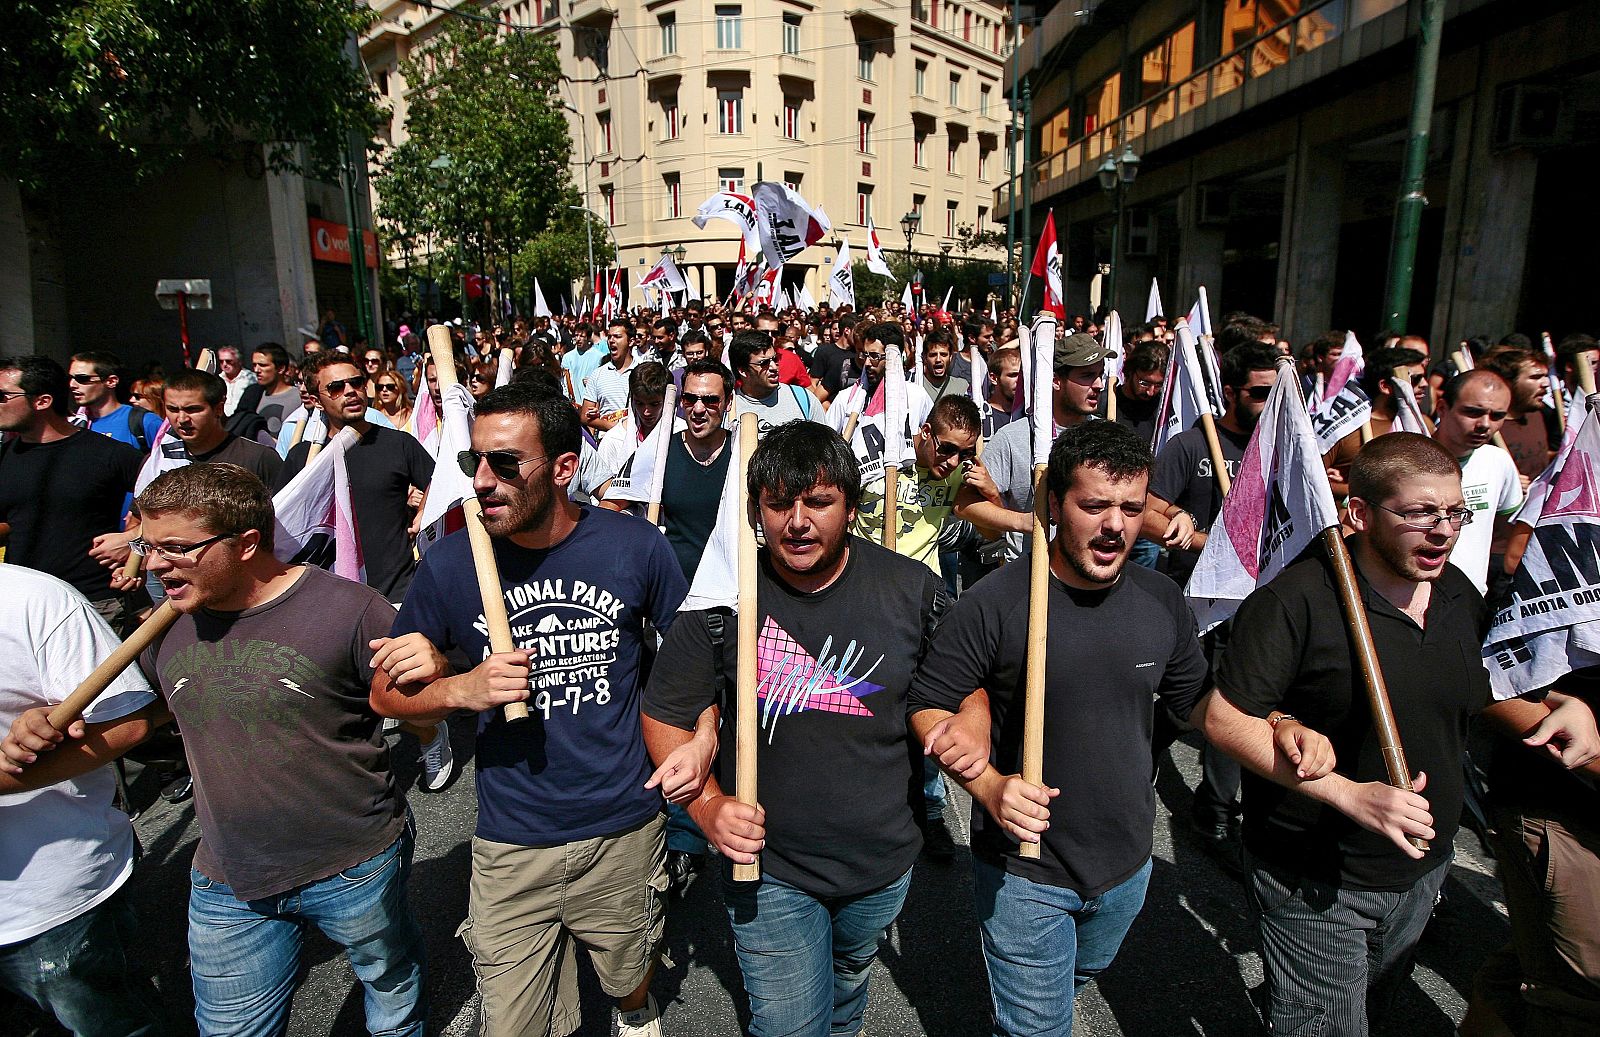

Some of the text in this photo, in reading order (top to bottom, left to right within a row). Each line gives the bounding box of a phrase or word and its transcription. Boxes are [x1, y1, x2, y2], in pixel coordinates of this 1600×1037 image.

[896, 481, 954, 507] IESEL
[472, 578, 625, 637] NIONAL PARK
[511, 616, 605, 638] AKE CAMP-
[539, 657, 556, 668] AND
[558, 652, 607, 666] RECREATION
[528, 665, 609, 690] TONIC STYLE
